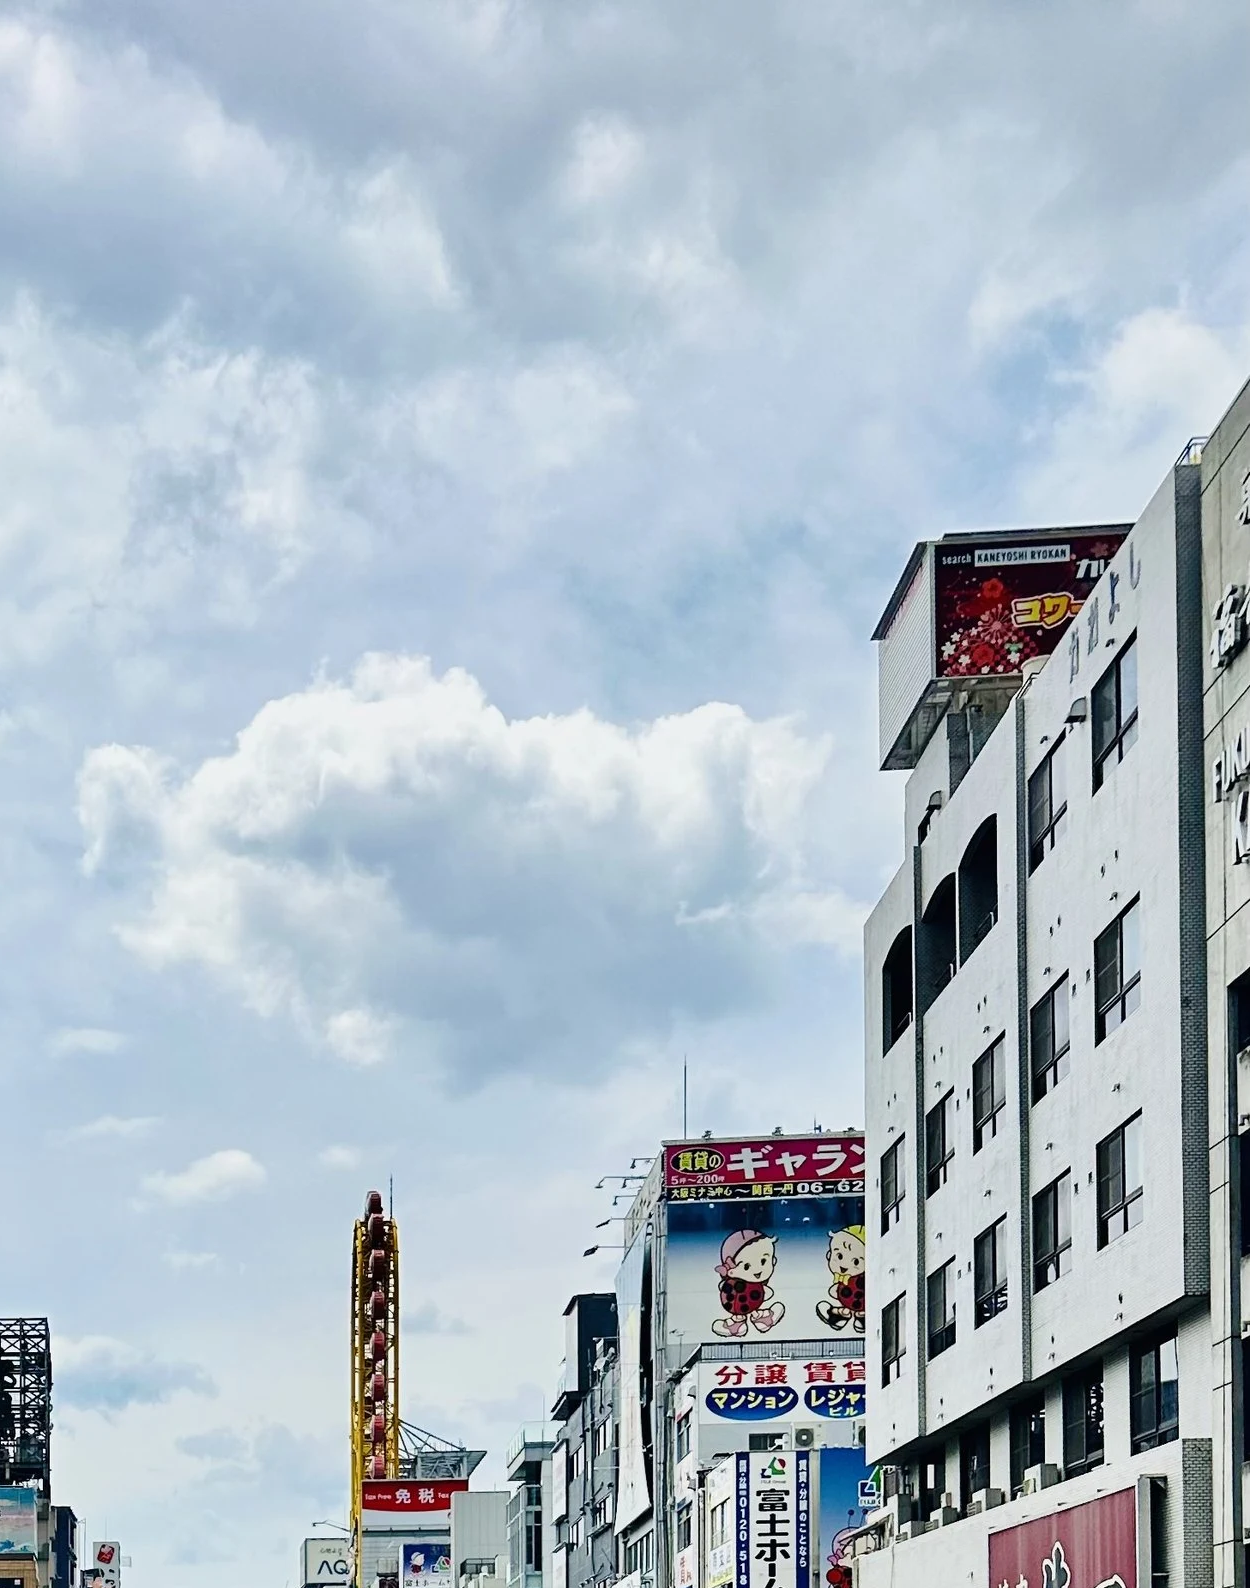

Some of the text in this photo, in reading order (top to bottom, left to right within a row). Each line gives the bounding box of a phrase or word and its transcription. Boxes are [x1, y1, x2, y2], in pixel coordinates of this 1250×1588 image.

[942, 548, 1067, 565] search KANEYOSHI RYOKAN
[678, 1151, 722, 1171] 賃貸の
[715, 1363, 788, 1386] 分譲
[712, 1390, 794, 1410] マンション
[811, 1387, 866, 1407] レジャ
[829, 1406, 858, 1417] ビル
[395, 1488, 435, 1504] 免税
[405, 1578, 450, 1587] 富士ホーム
